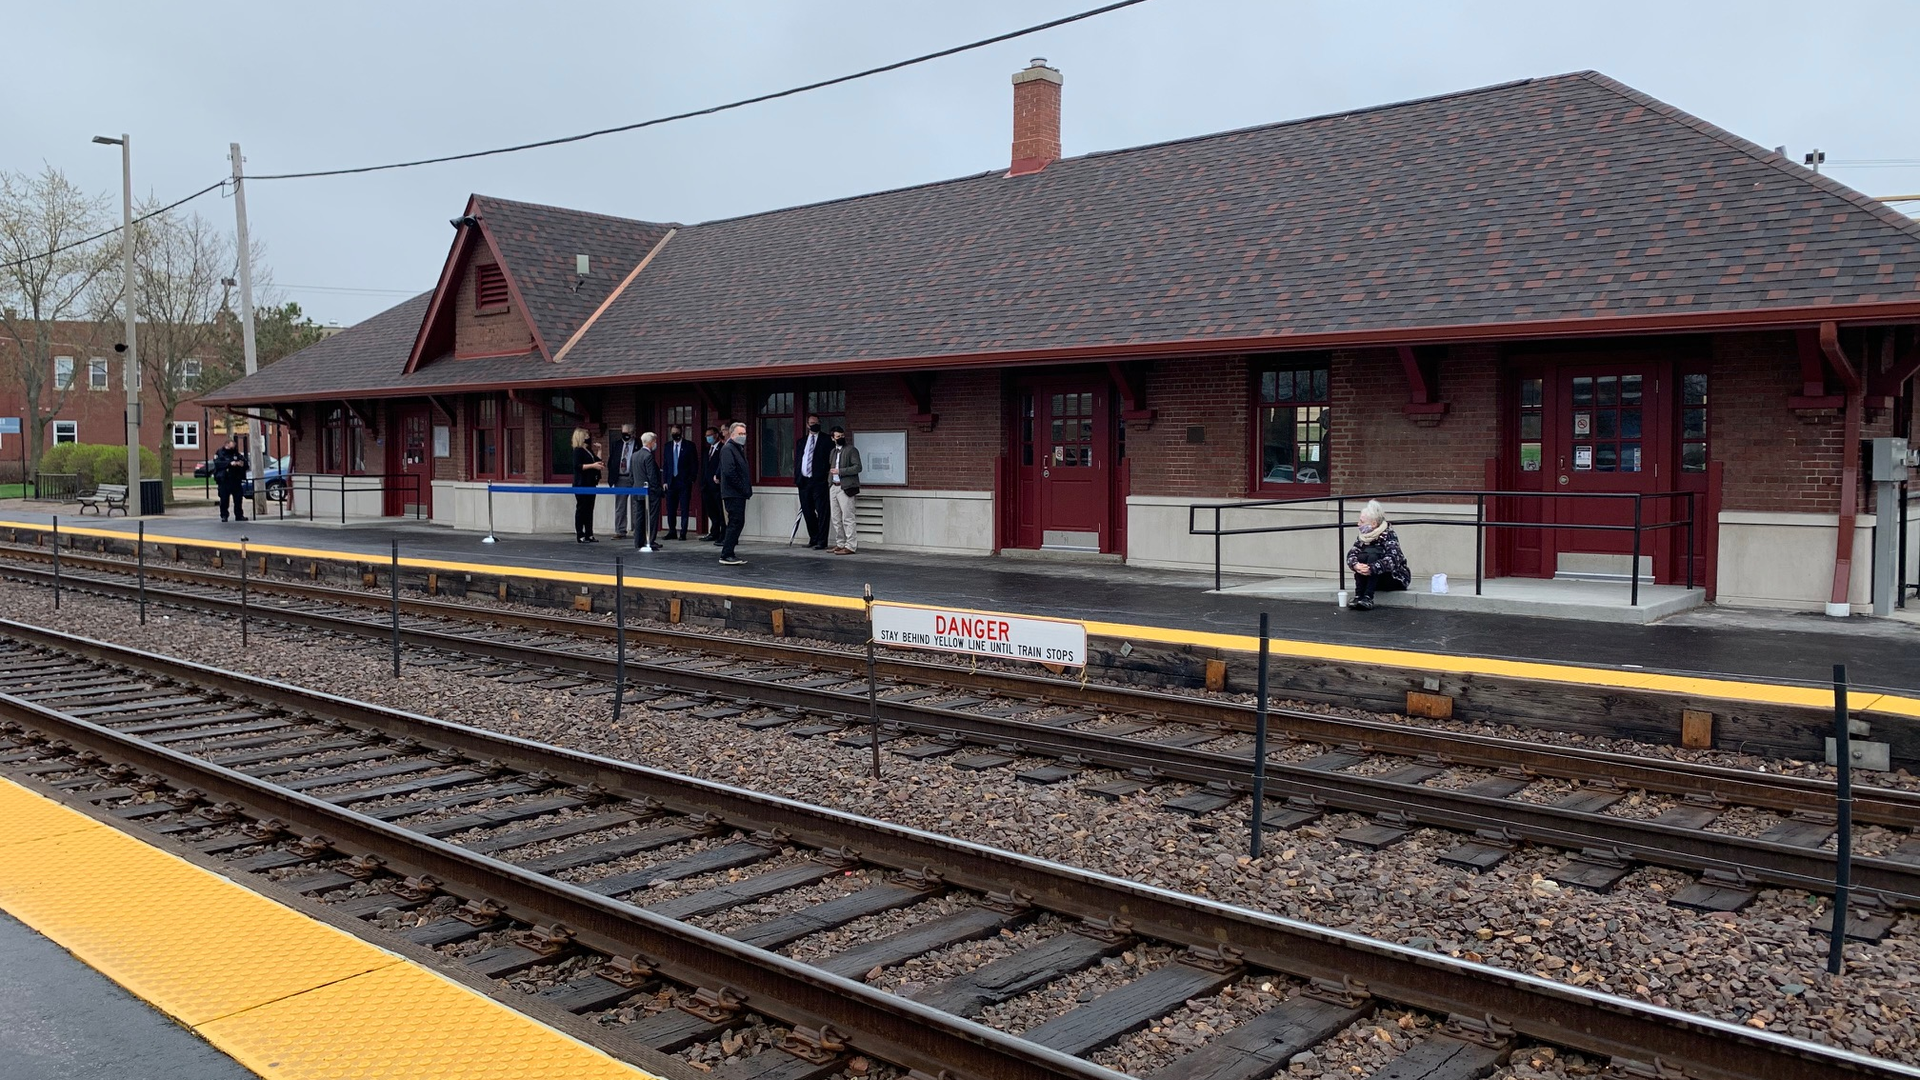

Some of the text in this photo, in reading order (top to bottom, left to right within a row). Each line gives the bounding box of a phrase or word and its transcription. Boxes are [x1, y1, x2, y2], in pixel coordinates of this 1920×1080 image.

[936, 615, 1009, 641] DANGER
[881, 630, 1074, 662] STAY BEHIND YELLOW LINE UNTIL TRAIN STOPS
